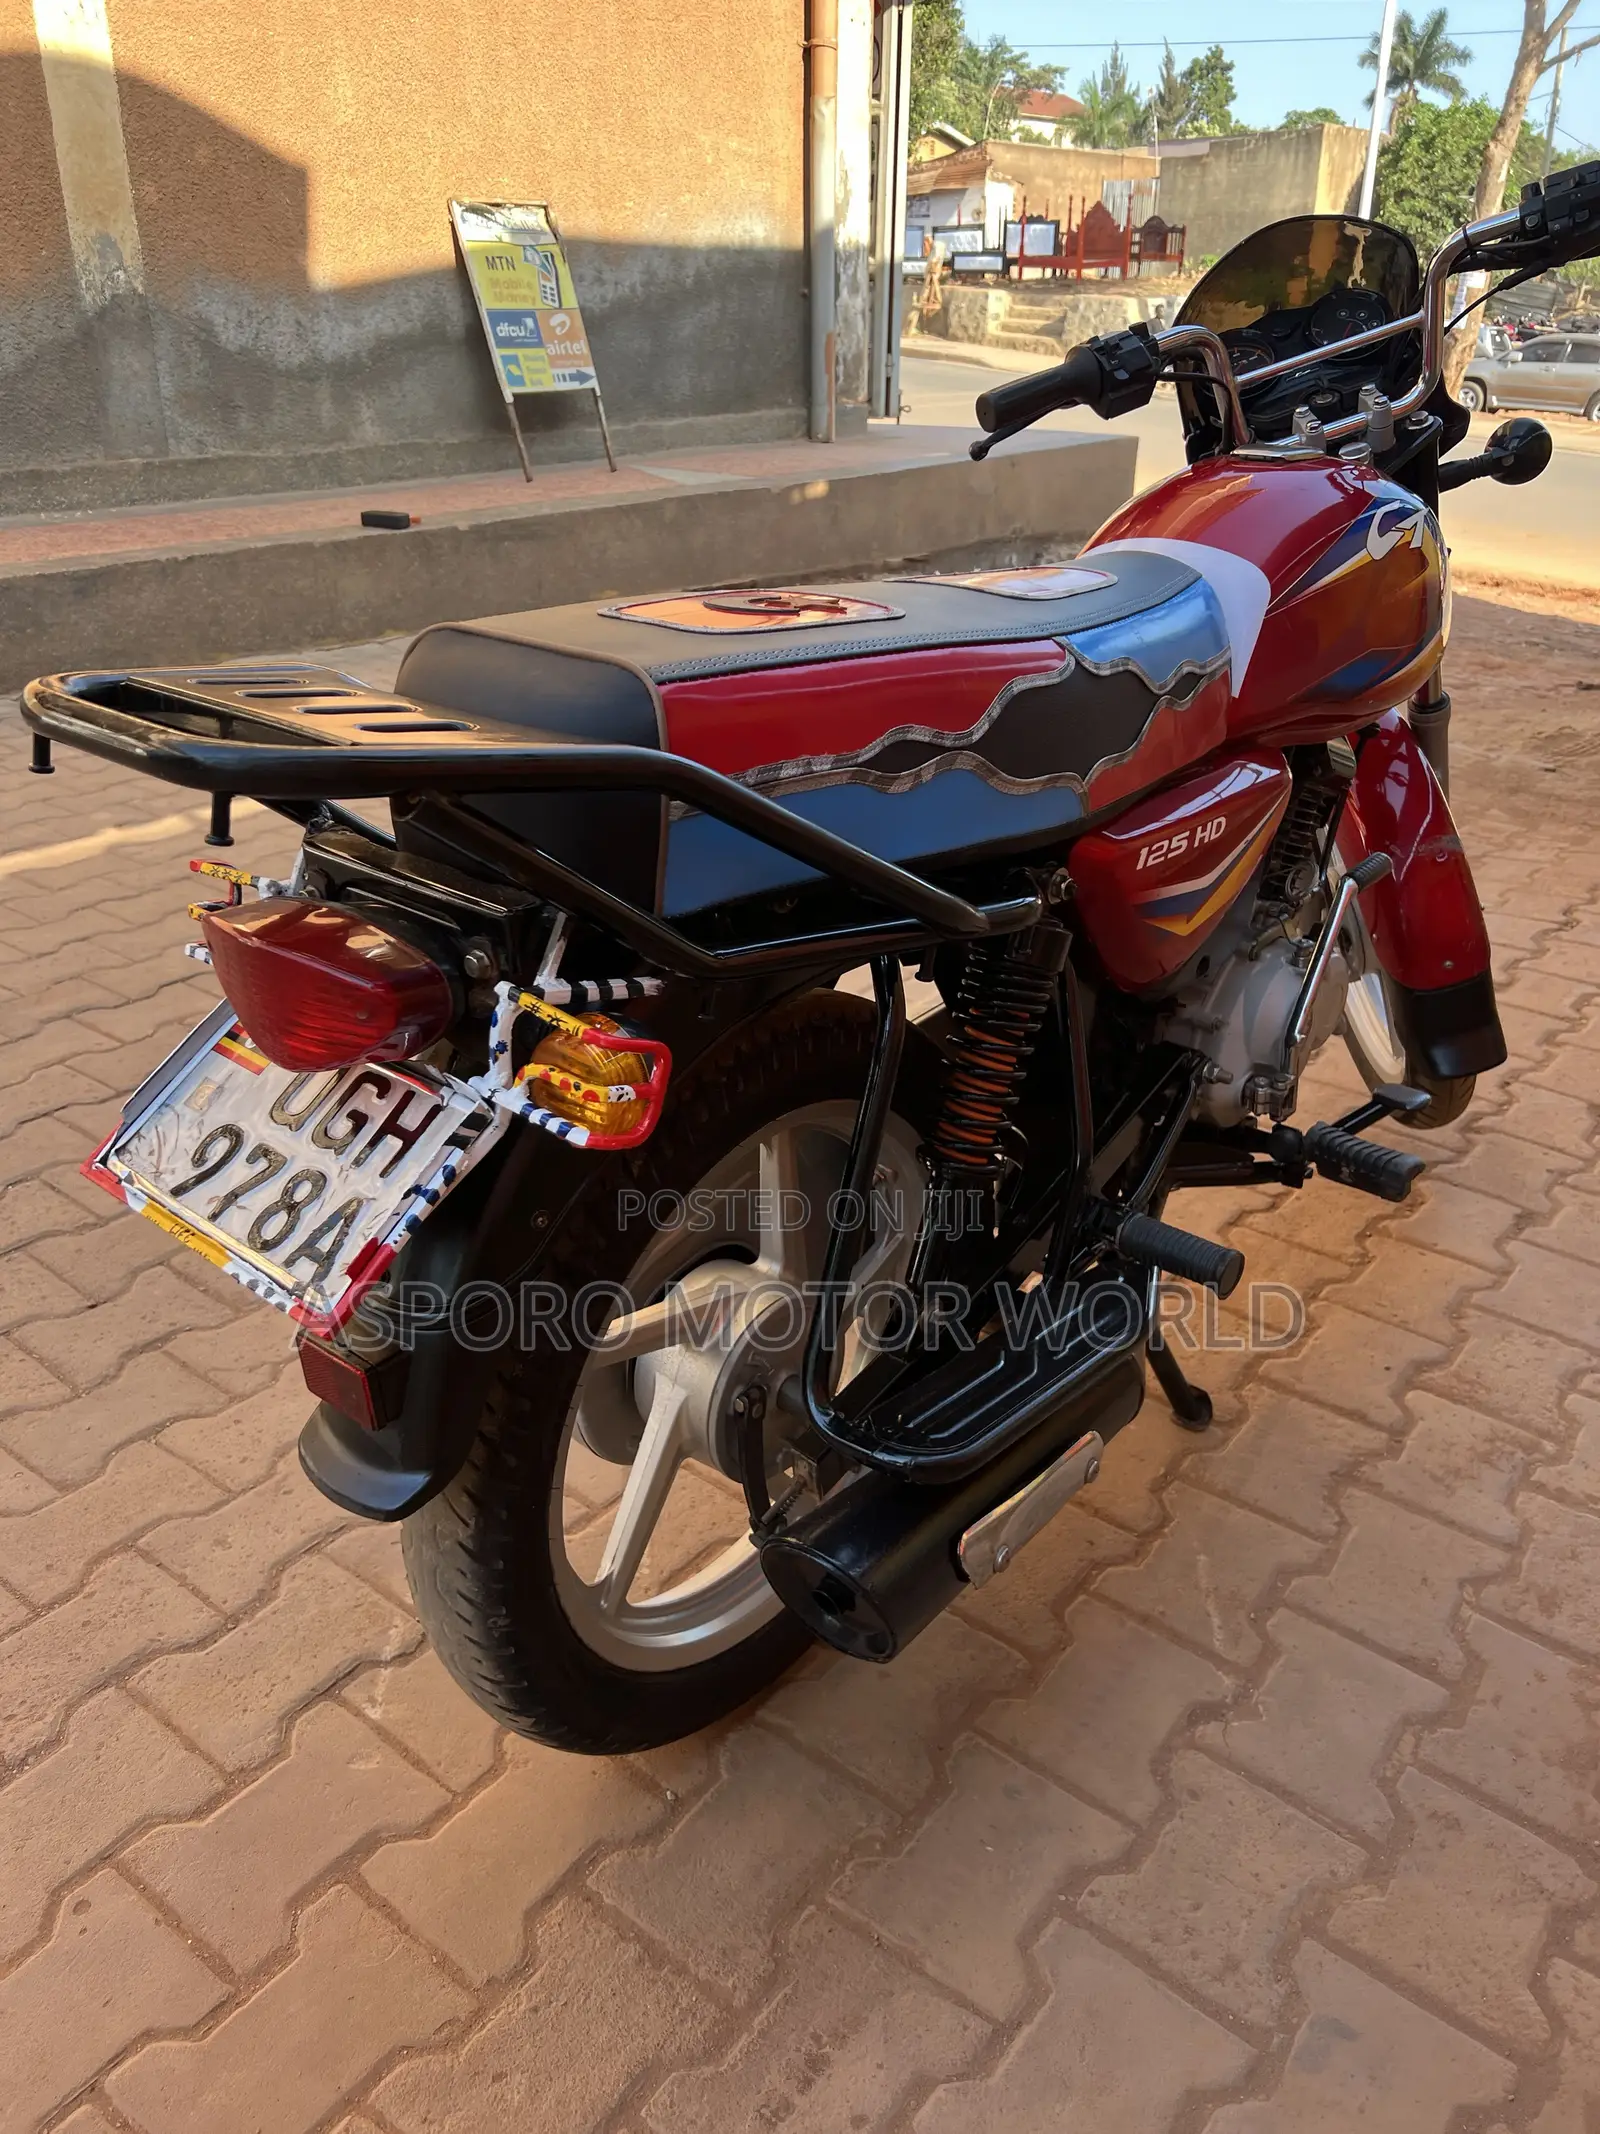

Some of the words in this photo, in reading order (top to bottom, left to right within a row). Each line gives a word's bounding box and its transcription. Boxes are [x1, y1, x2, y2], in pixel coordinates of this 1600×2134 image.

[485, 255, 516, 271] MTN
[489, 277, 533, 290] Mobile
[493, 291, 536, 306] Money
[496, 325, 525, 337] dfcu
[547, 340, 587, 355] airtel
[1136, 830, 1190, 871] 125
[1193, 816, 1227, 848] HD
[269, 1067, 445, 1179] UGH
[169, 1123, 365, 1287] 978A
